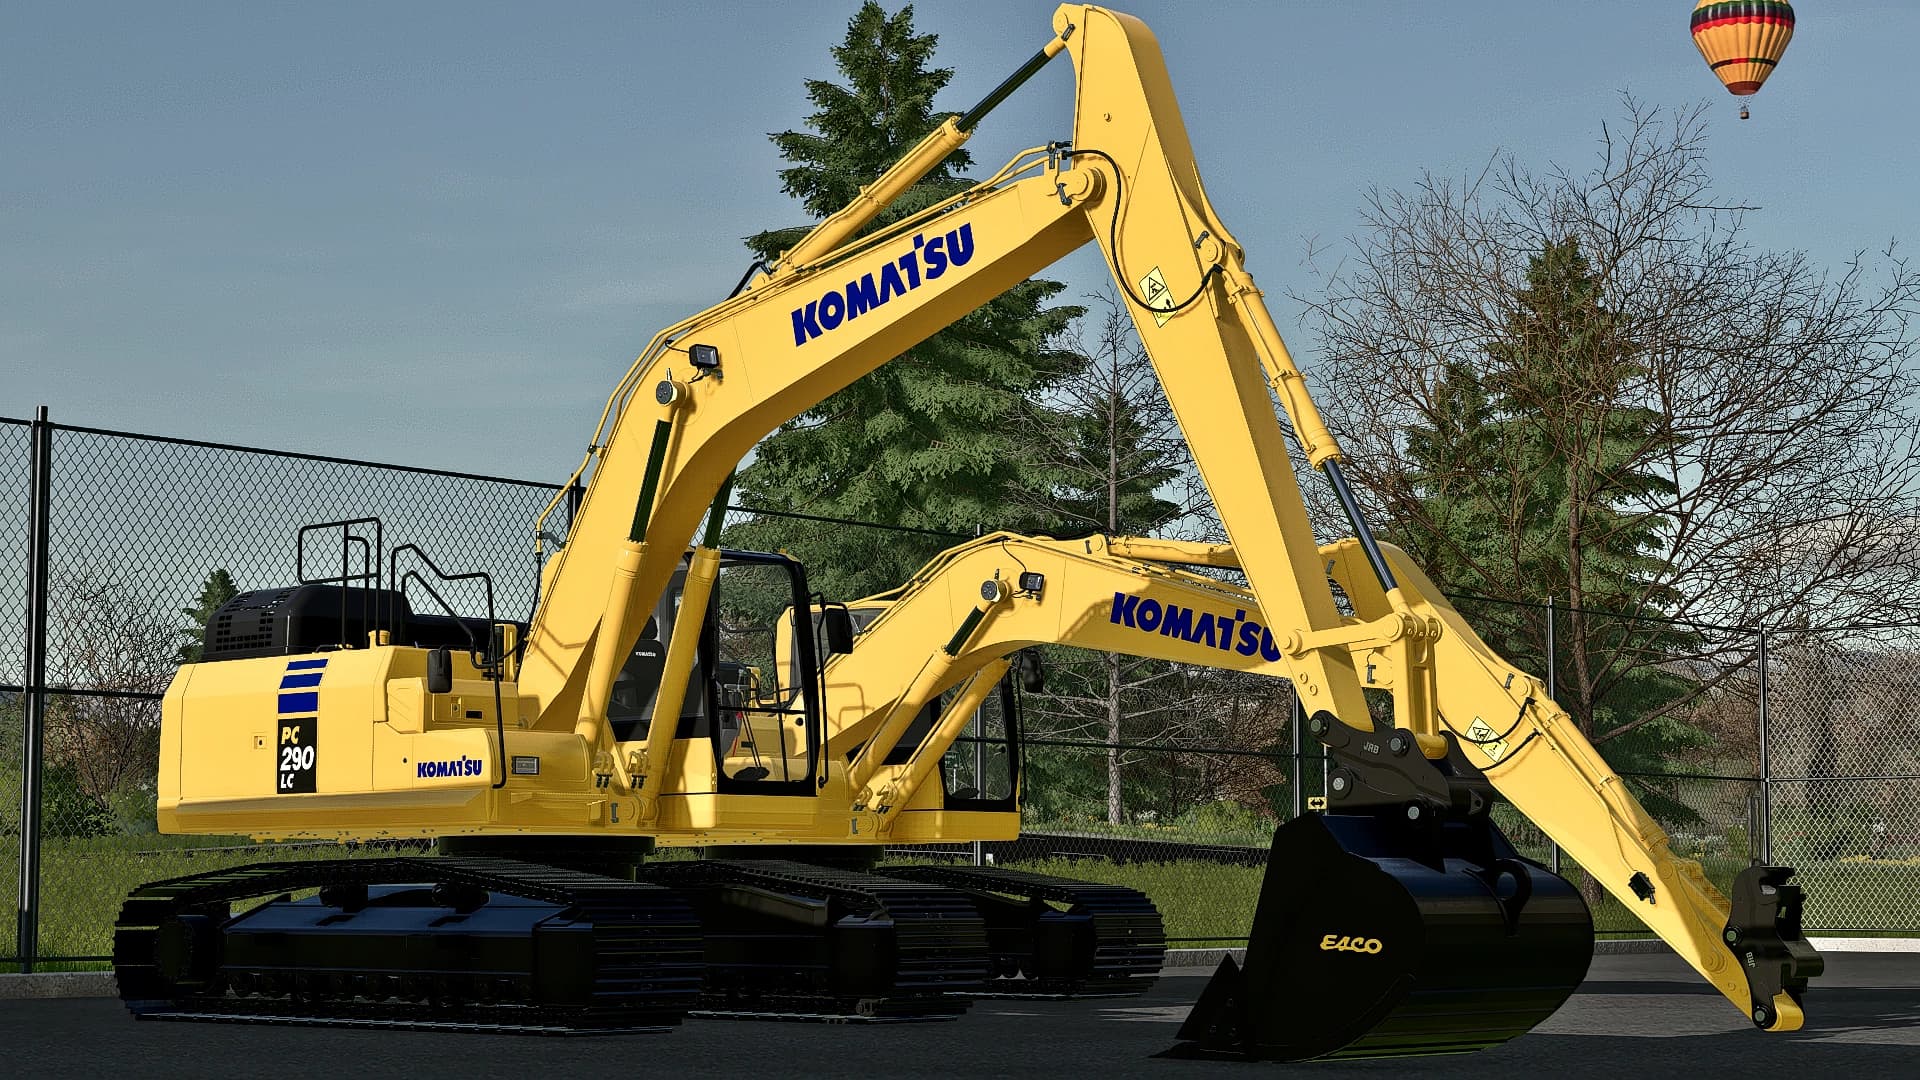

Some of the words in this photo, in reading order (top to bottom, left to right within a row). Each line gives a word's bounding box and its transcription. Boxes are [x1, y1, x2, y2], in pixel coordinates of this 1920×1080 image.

[791, 222, 975, 347] KOMATSU
[281, 725, 300, 745] PC
[280, 745, 315, 771] 290
[417, 755, 483, 778] KOMATSU
[280, 773, 295, 789] LC
